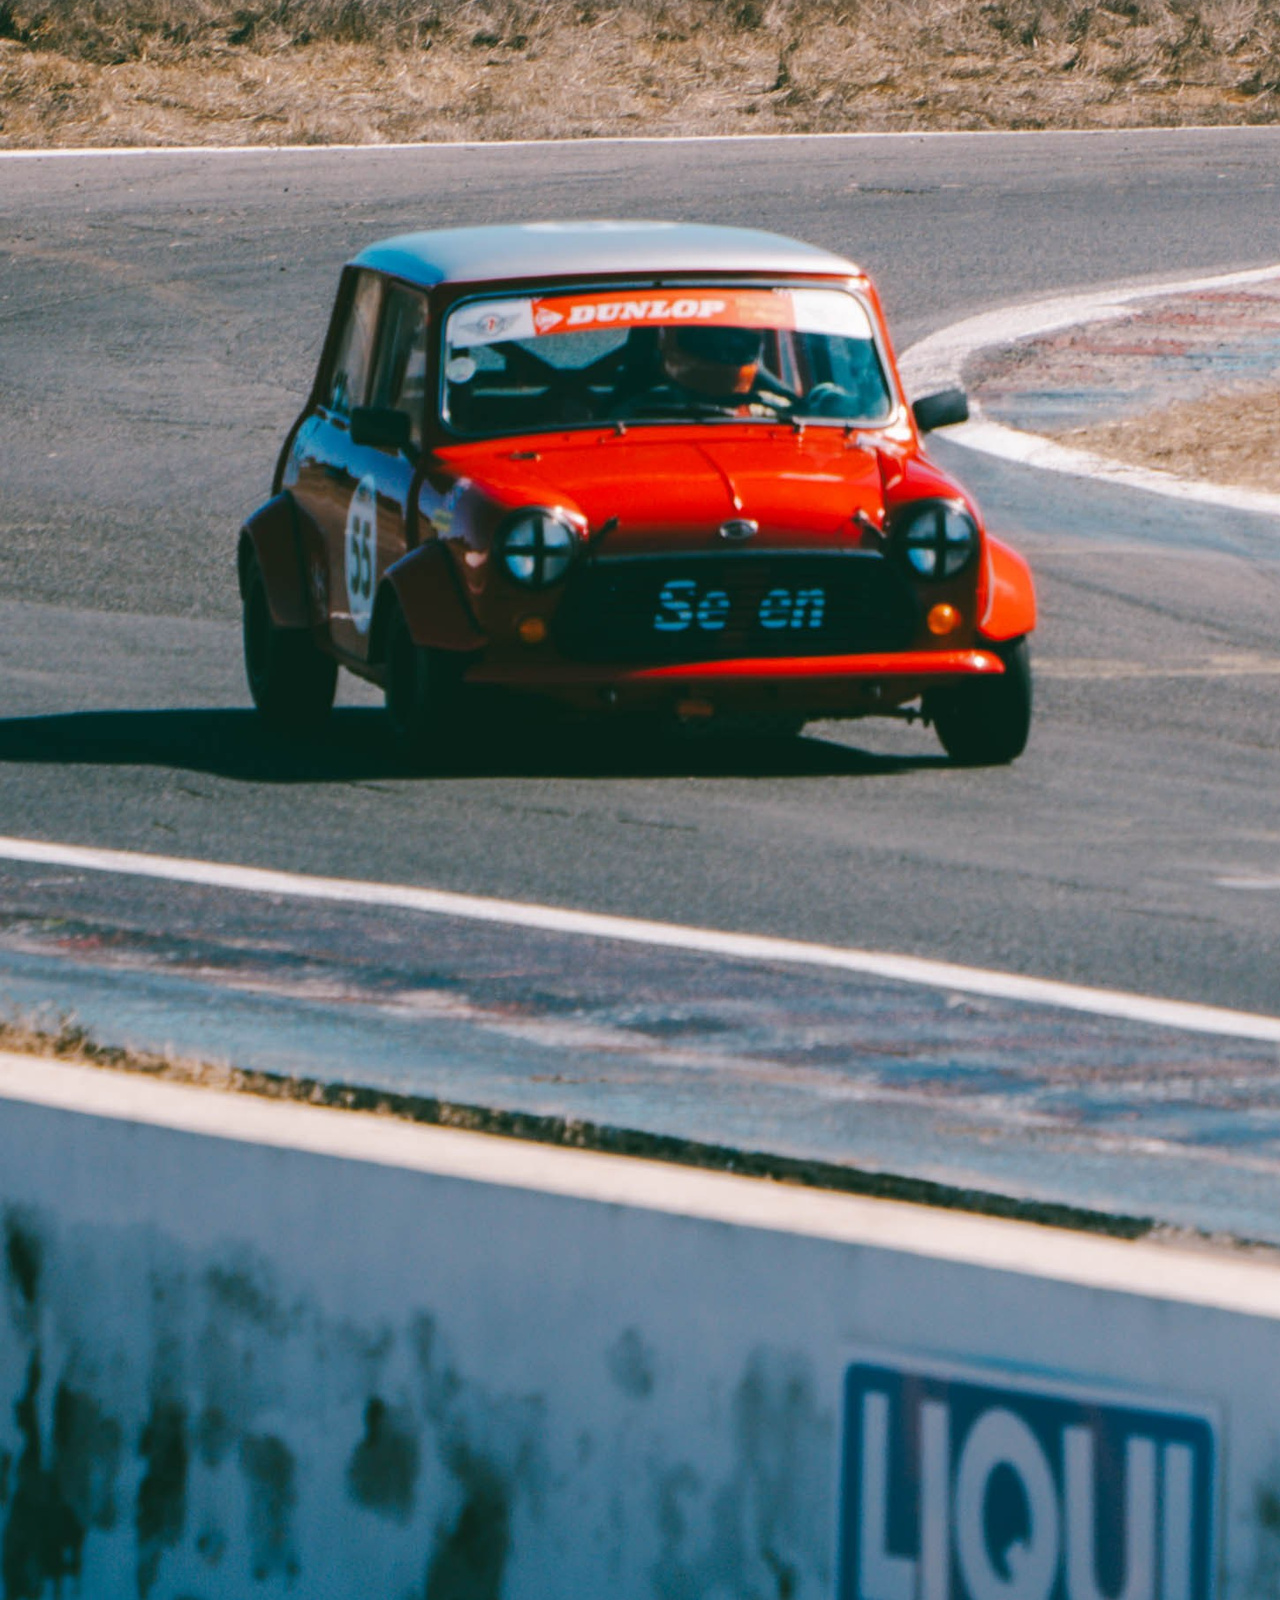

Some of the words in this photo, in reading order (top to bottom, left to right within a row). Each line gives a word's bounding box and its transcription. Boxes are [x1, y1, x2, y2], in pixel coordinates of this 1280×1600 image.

[566, 299, 727, 325] DUNLOP
[351, 514, 371, 600] 55
[857, 1391, 1195, 1600] LIQUI
